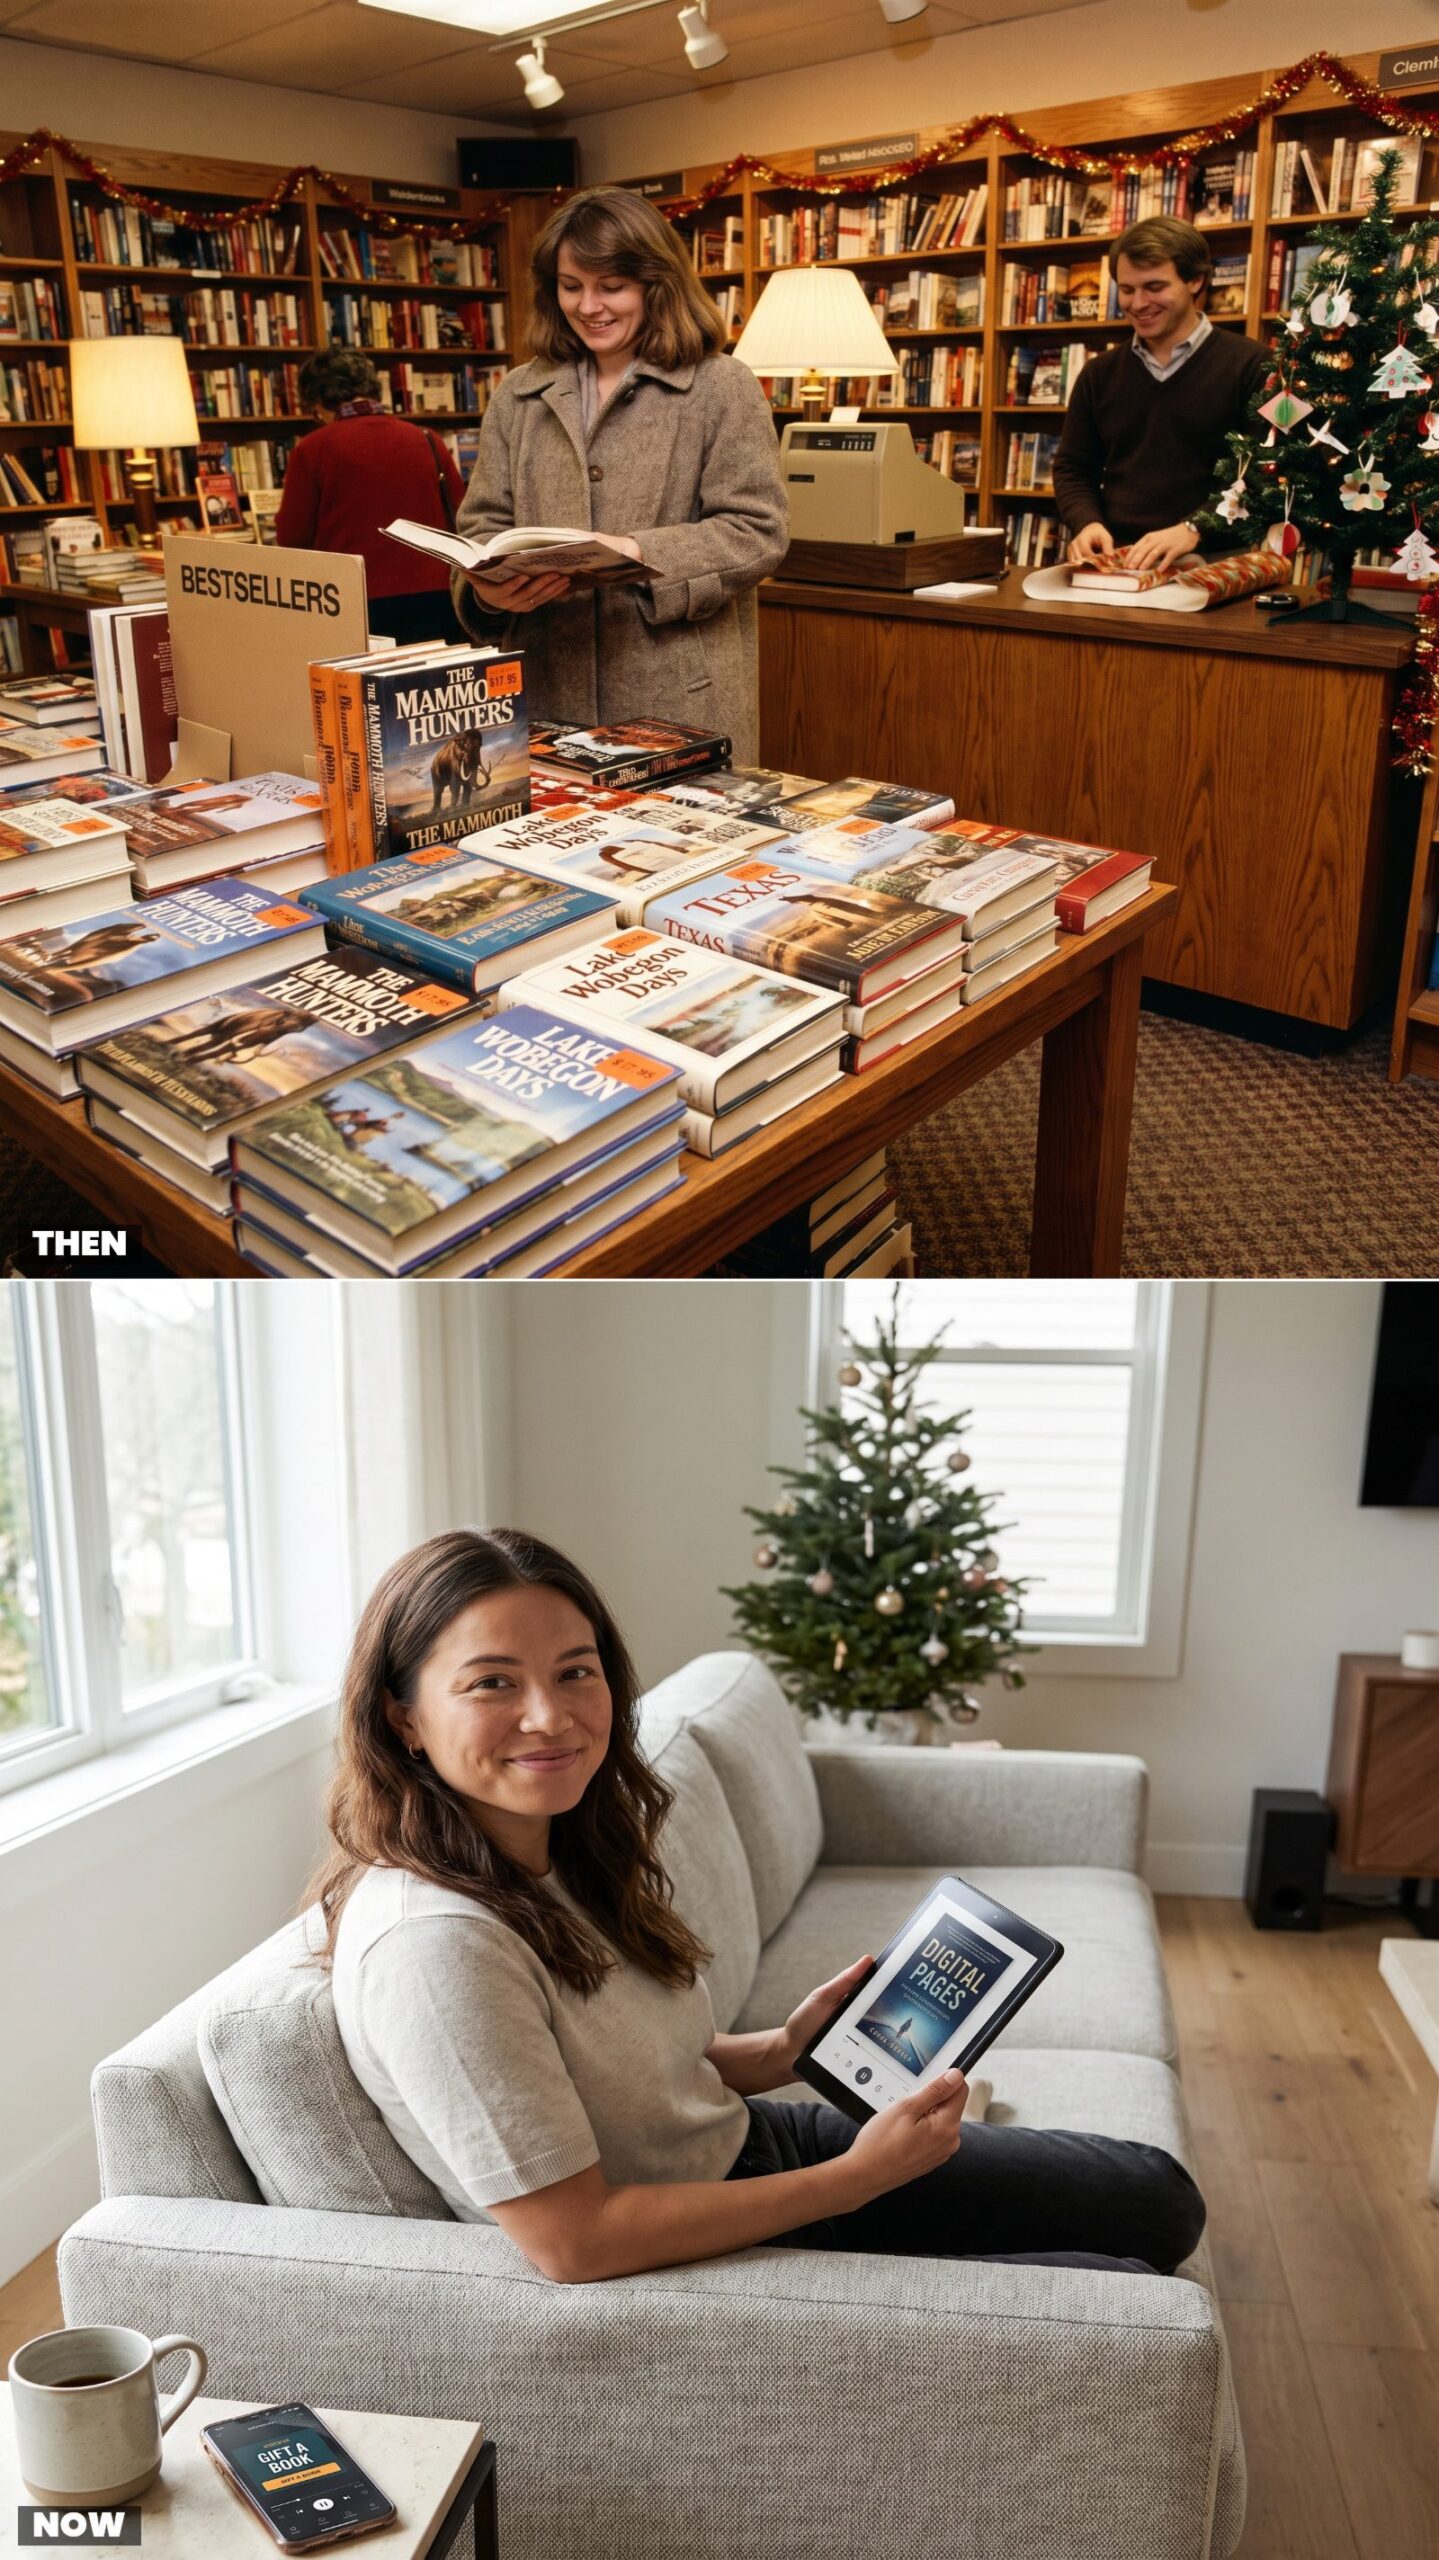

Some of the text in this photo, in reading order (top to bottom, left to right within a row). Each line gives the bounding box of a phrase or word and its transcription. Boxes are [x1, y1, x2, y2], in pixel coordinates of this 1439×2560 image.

[181, 564, 341, 617] BESTSELLERS
[367, 683, 376, 701] THE
[447, 666, 475, 684] THE
[395, 679, 521, 719] MAMMO
[368, 704, 384, 768] MAMMOTH
[408, 699, 514, 746] HUNTERS
[407, 827, 441, 849] THE
[443, 802, 523, 839] MAMMOTH
[495, 814, 609, 851] Wobegon
[544, 828, 609, 851] Days
[167, 888, 276, 937] MAMMOTH
[230, 893, 272, 911] THE
[682, 871, 801, 917] TEXAS
[135, 900, 238, 945] HUNTERS
[664, 918, 725, 953] TEXAS
[290, 960, 430, 1025] MAMMOTH
[366, 967, 415, 991] THE
[560, 947, 686, 1000] Wobegon
[616, 967, 688, 999] Days
[256, 976, 390, 1037] HUNTERS
[465, 1054, 554, 1099] DAYS
[473, 1025, 631, 1102] WOBEGON
[909, 1961, 966, 2010] PAGES
[921, 1938, 987, 1995] DIGITAL
[257, 2446, 293, 2463] GIFT
[295, 2442, 309, 2453] A
[268, 2453, 314, 2473] BOOK
